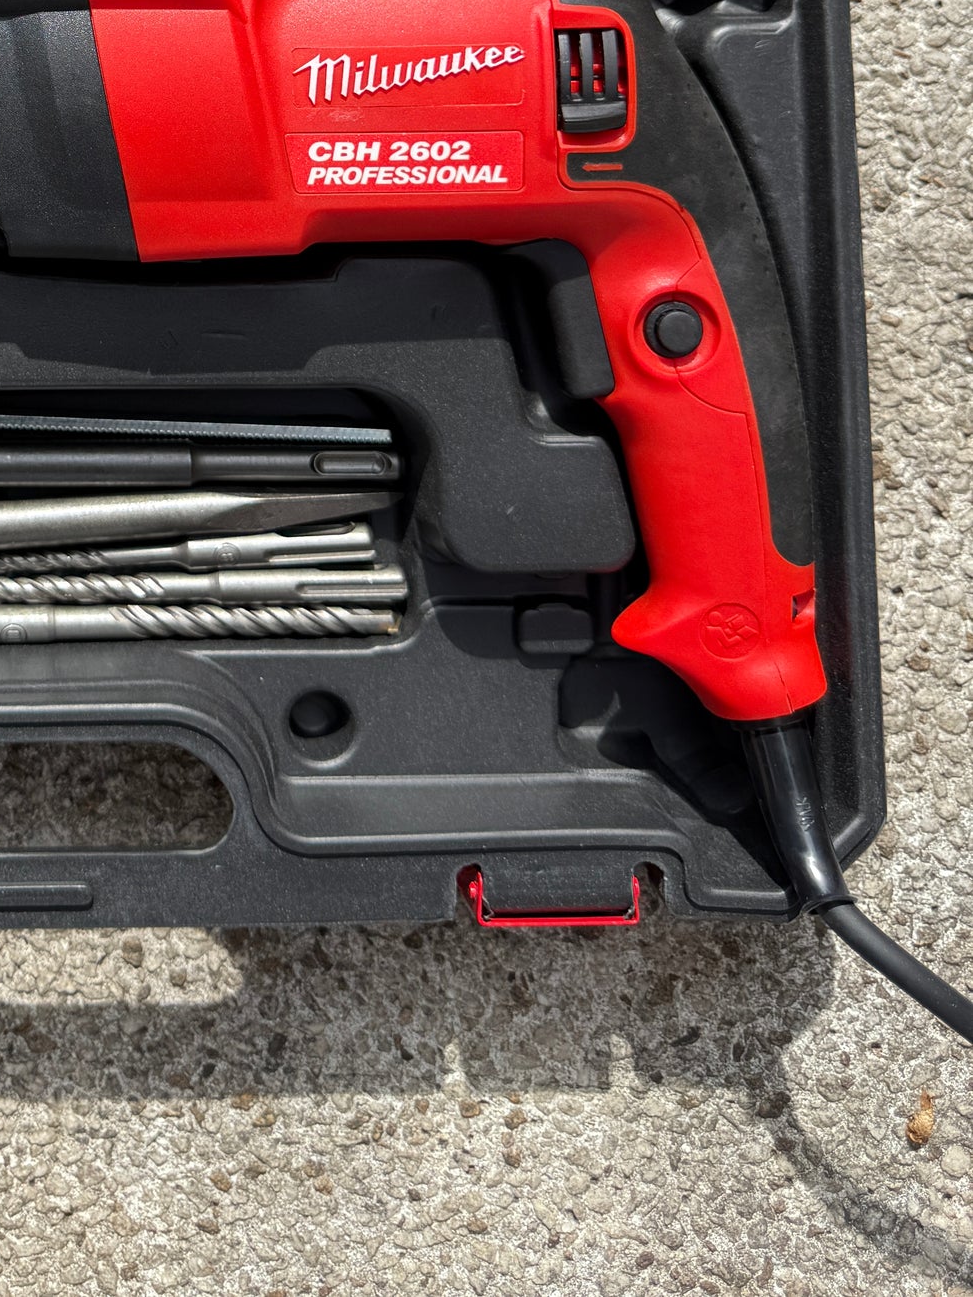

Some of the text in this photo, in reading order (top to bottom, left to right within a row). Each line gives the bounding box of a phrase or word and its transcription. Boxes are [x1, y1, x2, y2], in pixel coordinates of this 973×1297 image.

[292, 45, 526, 105] Milwaukee
[308, 140, 472, 162] CBH 2602
[307, 165, 508, 185] PROFESSIONAL
